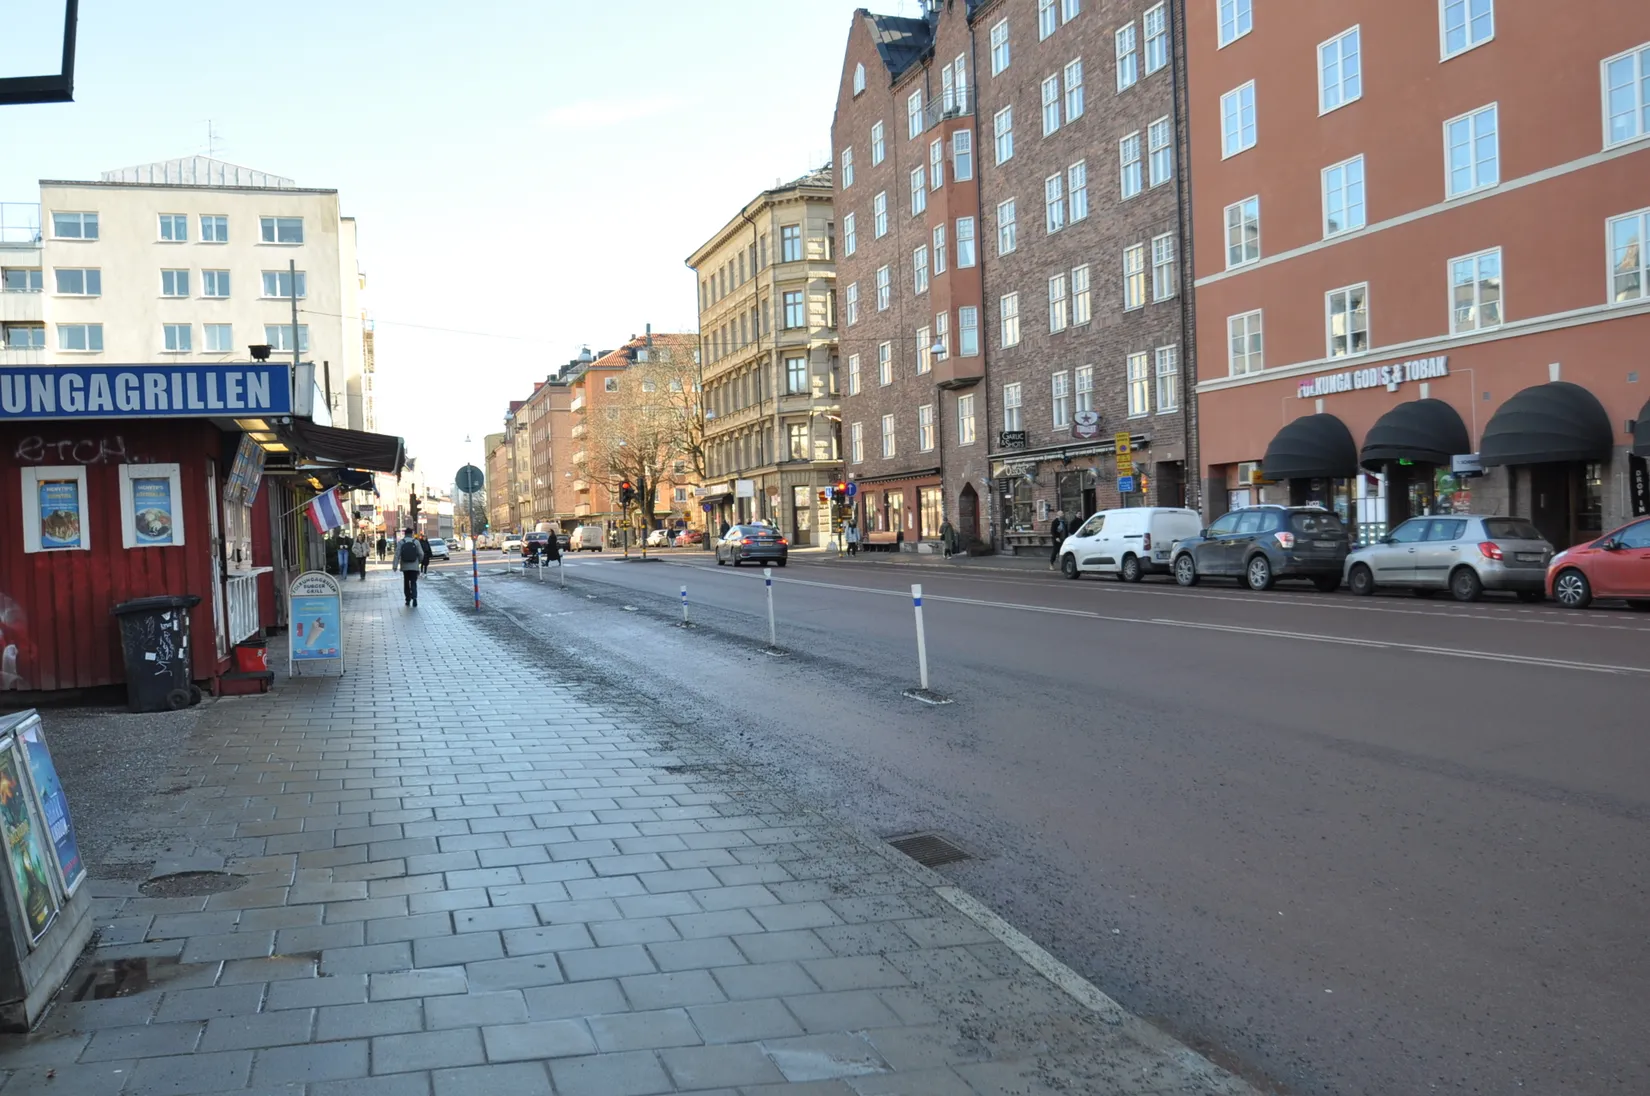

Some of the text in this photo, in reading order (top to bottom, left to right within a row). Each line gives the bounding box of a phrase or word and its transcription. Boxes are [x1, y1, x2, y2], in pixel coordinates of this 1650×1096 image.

[1, 372, 270, 413] UNGAGRILLEN
[1297, 355, 1448, 399] FOLKUNGA GODIS & TOBAK
[1635, 470, 1644, 497] DROP
